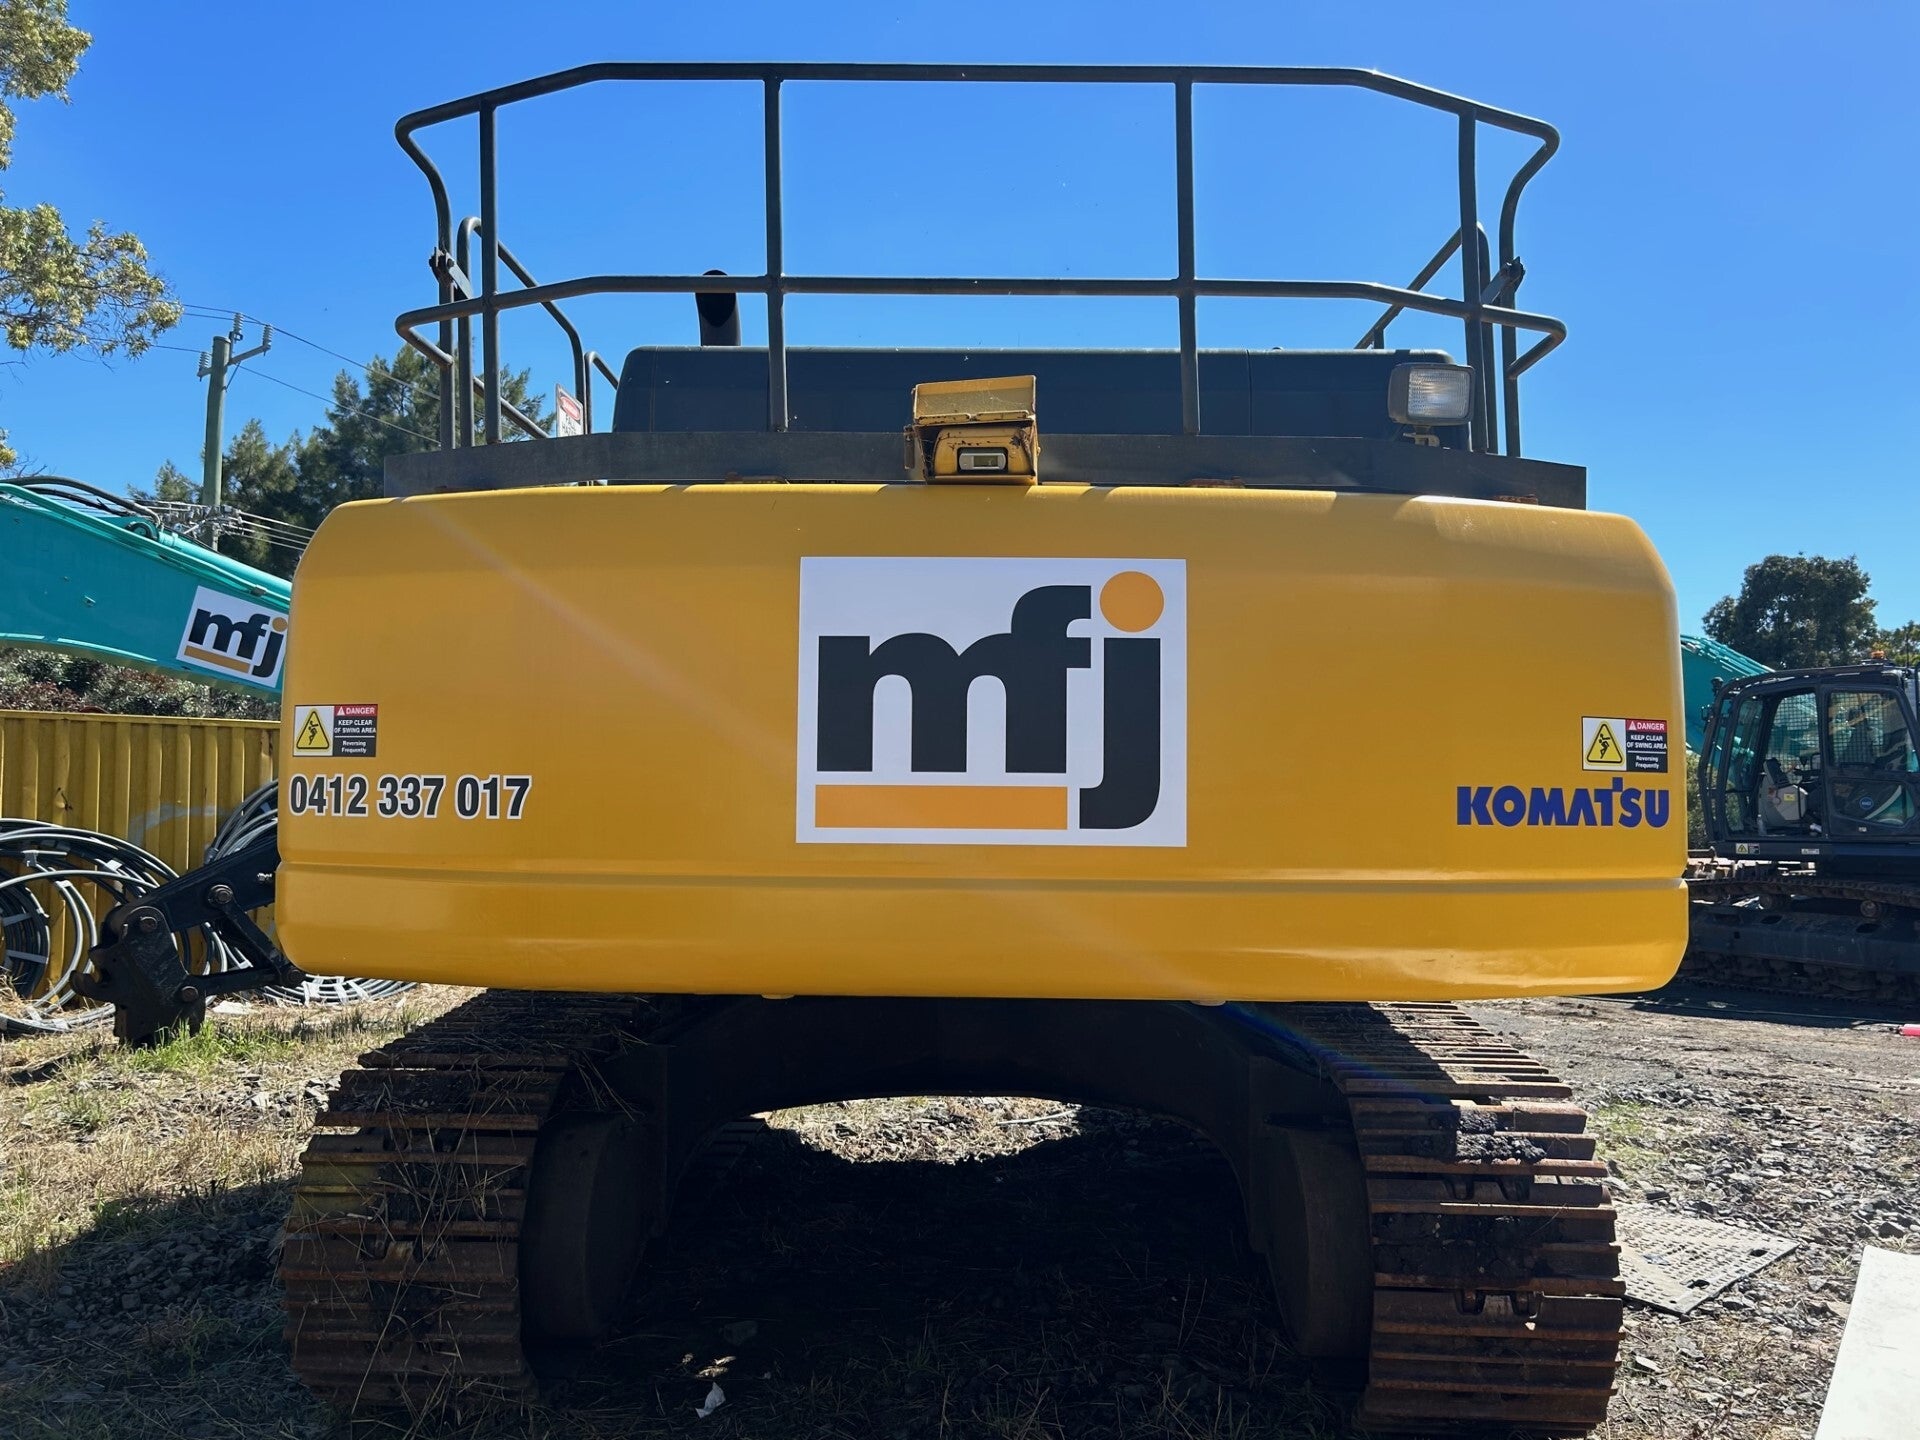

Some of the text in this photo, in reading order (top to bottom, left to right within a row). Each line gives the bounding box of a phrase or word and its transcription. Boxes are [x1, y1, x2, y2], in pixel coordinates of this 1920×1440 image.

[188, 608, 288, 677] mfj
[346, 707, 375, 715] DANGER
[817, 571, 1165, 829] mfj
[289, 773, 532, 820] 0412 337 017
[1456, 777, 1669, 828] KOMATSU
